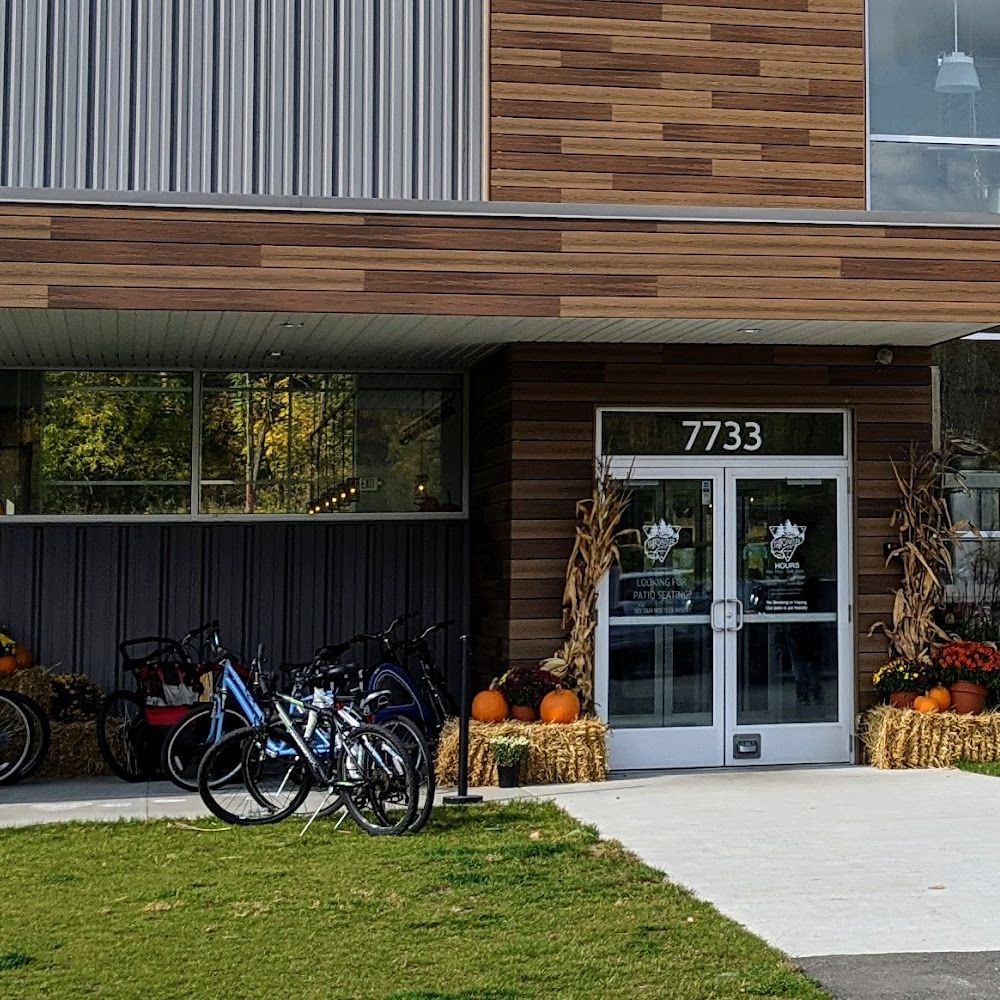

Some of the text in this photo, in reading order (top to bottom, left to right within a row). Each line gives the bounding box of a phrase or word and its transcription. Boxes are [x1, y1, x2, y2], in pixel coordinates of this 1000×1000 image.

[682, 421, 762, 451] 7733
[636, 578, 687, 587] LOOKING FOR
[633, 590, 656, 600] PATIO
